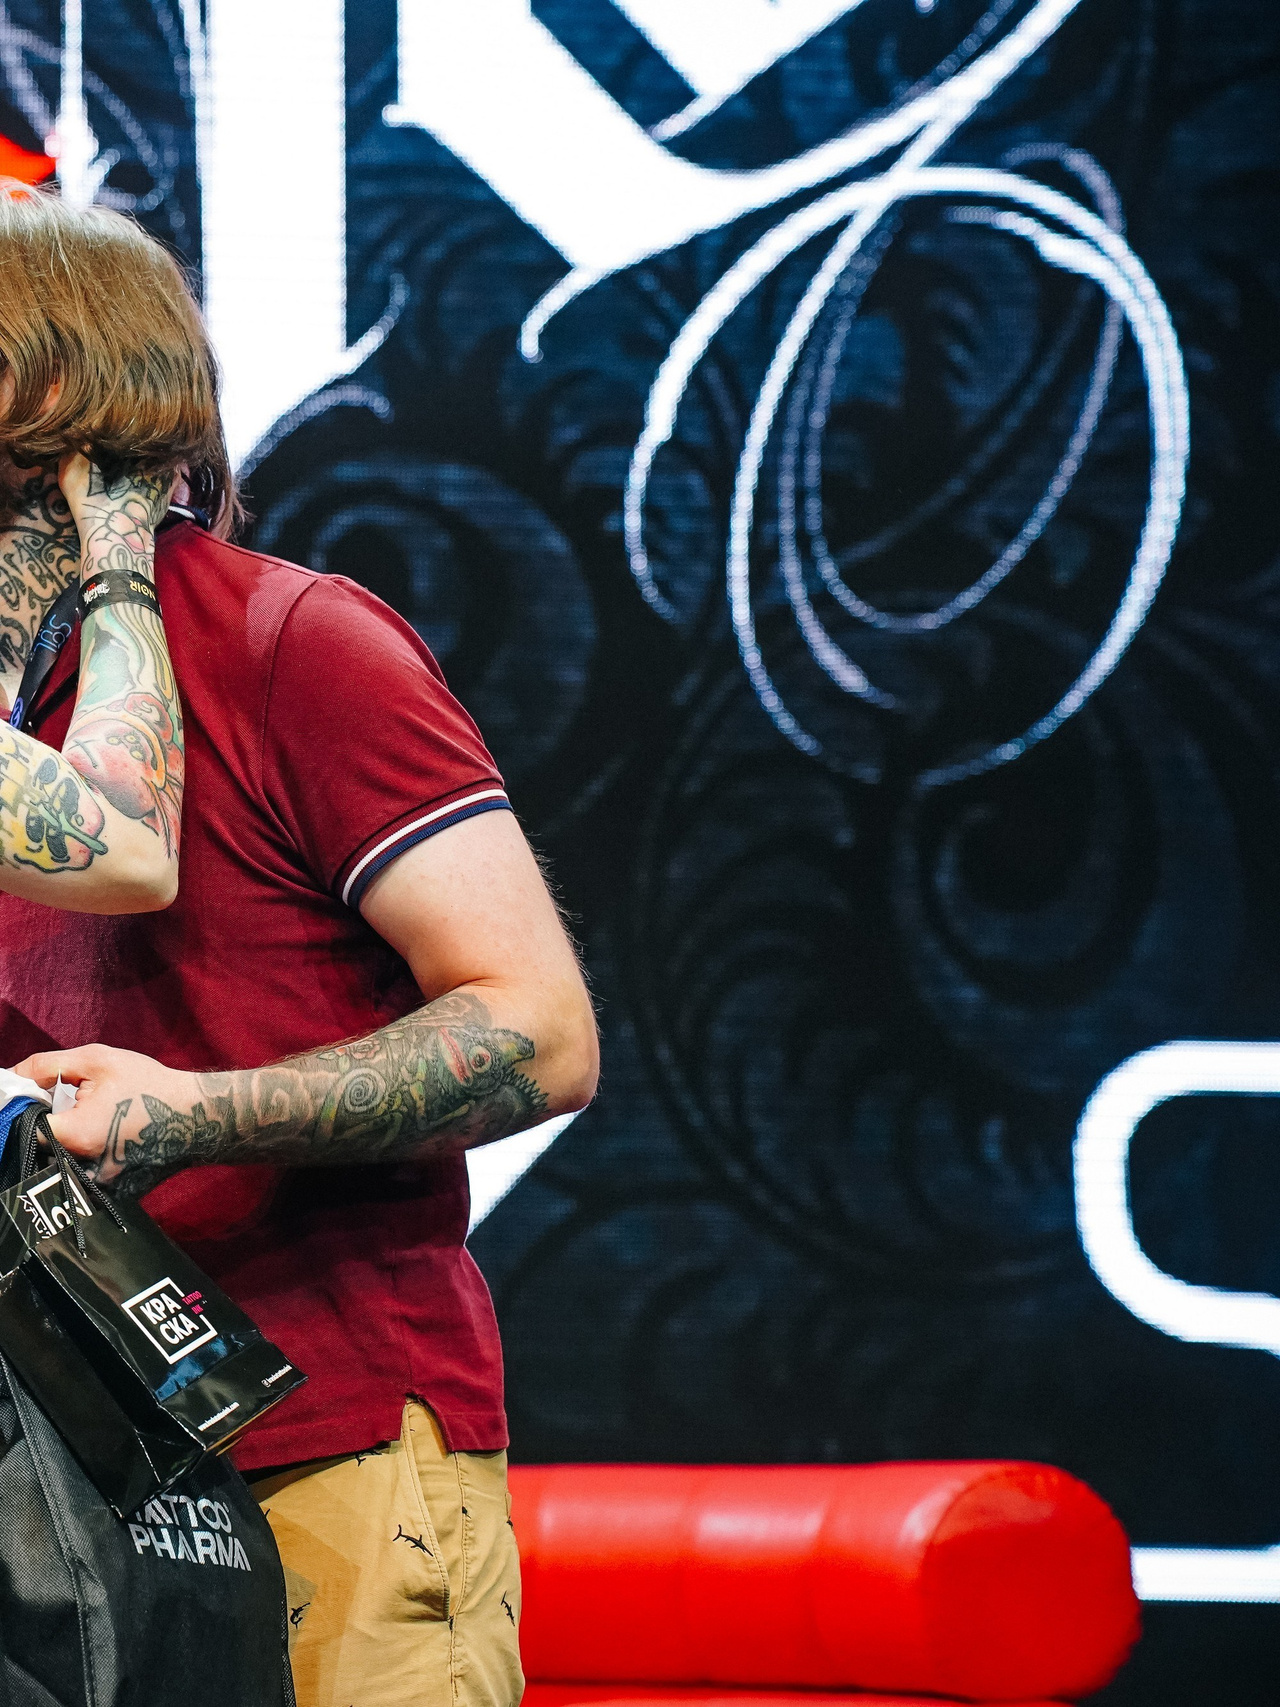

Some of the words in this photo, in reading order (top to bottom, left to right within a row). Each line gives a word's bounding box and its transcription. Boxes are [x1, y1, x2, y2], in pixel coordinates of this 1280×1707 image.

[139, 1292, 182, 1326] КРА
[181, 1290, 203, 1306] TATTOO
[159, 1312, 200, 1345] СКА
[134, 1493, 233, 1534] ATTOO
